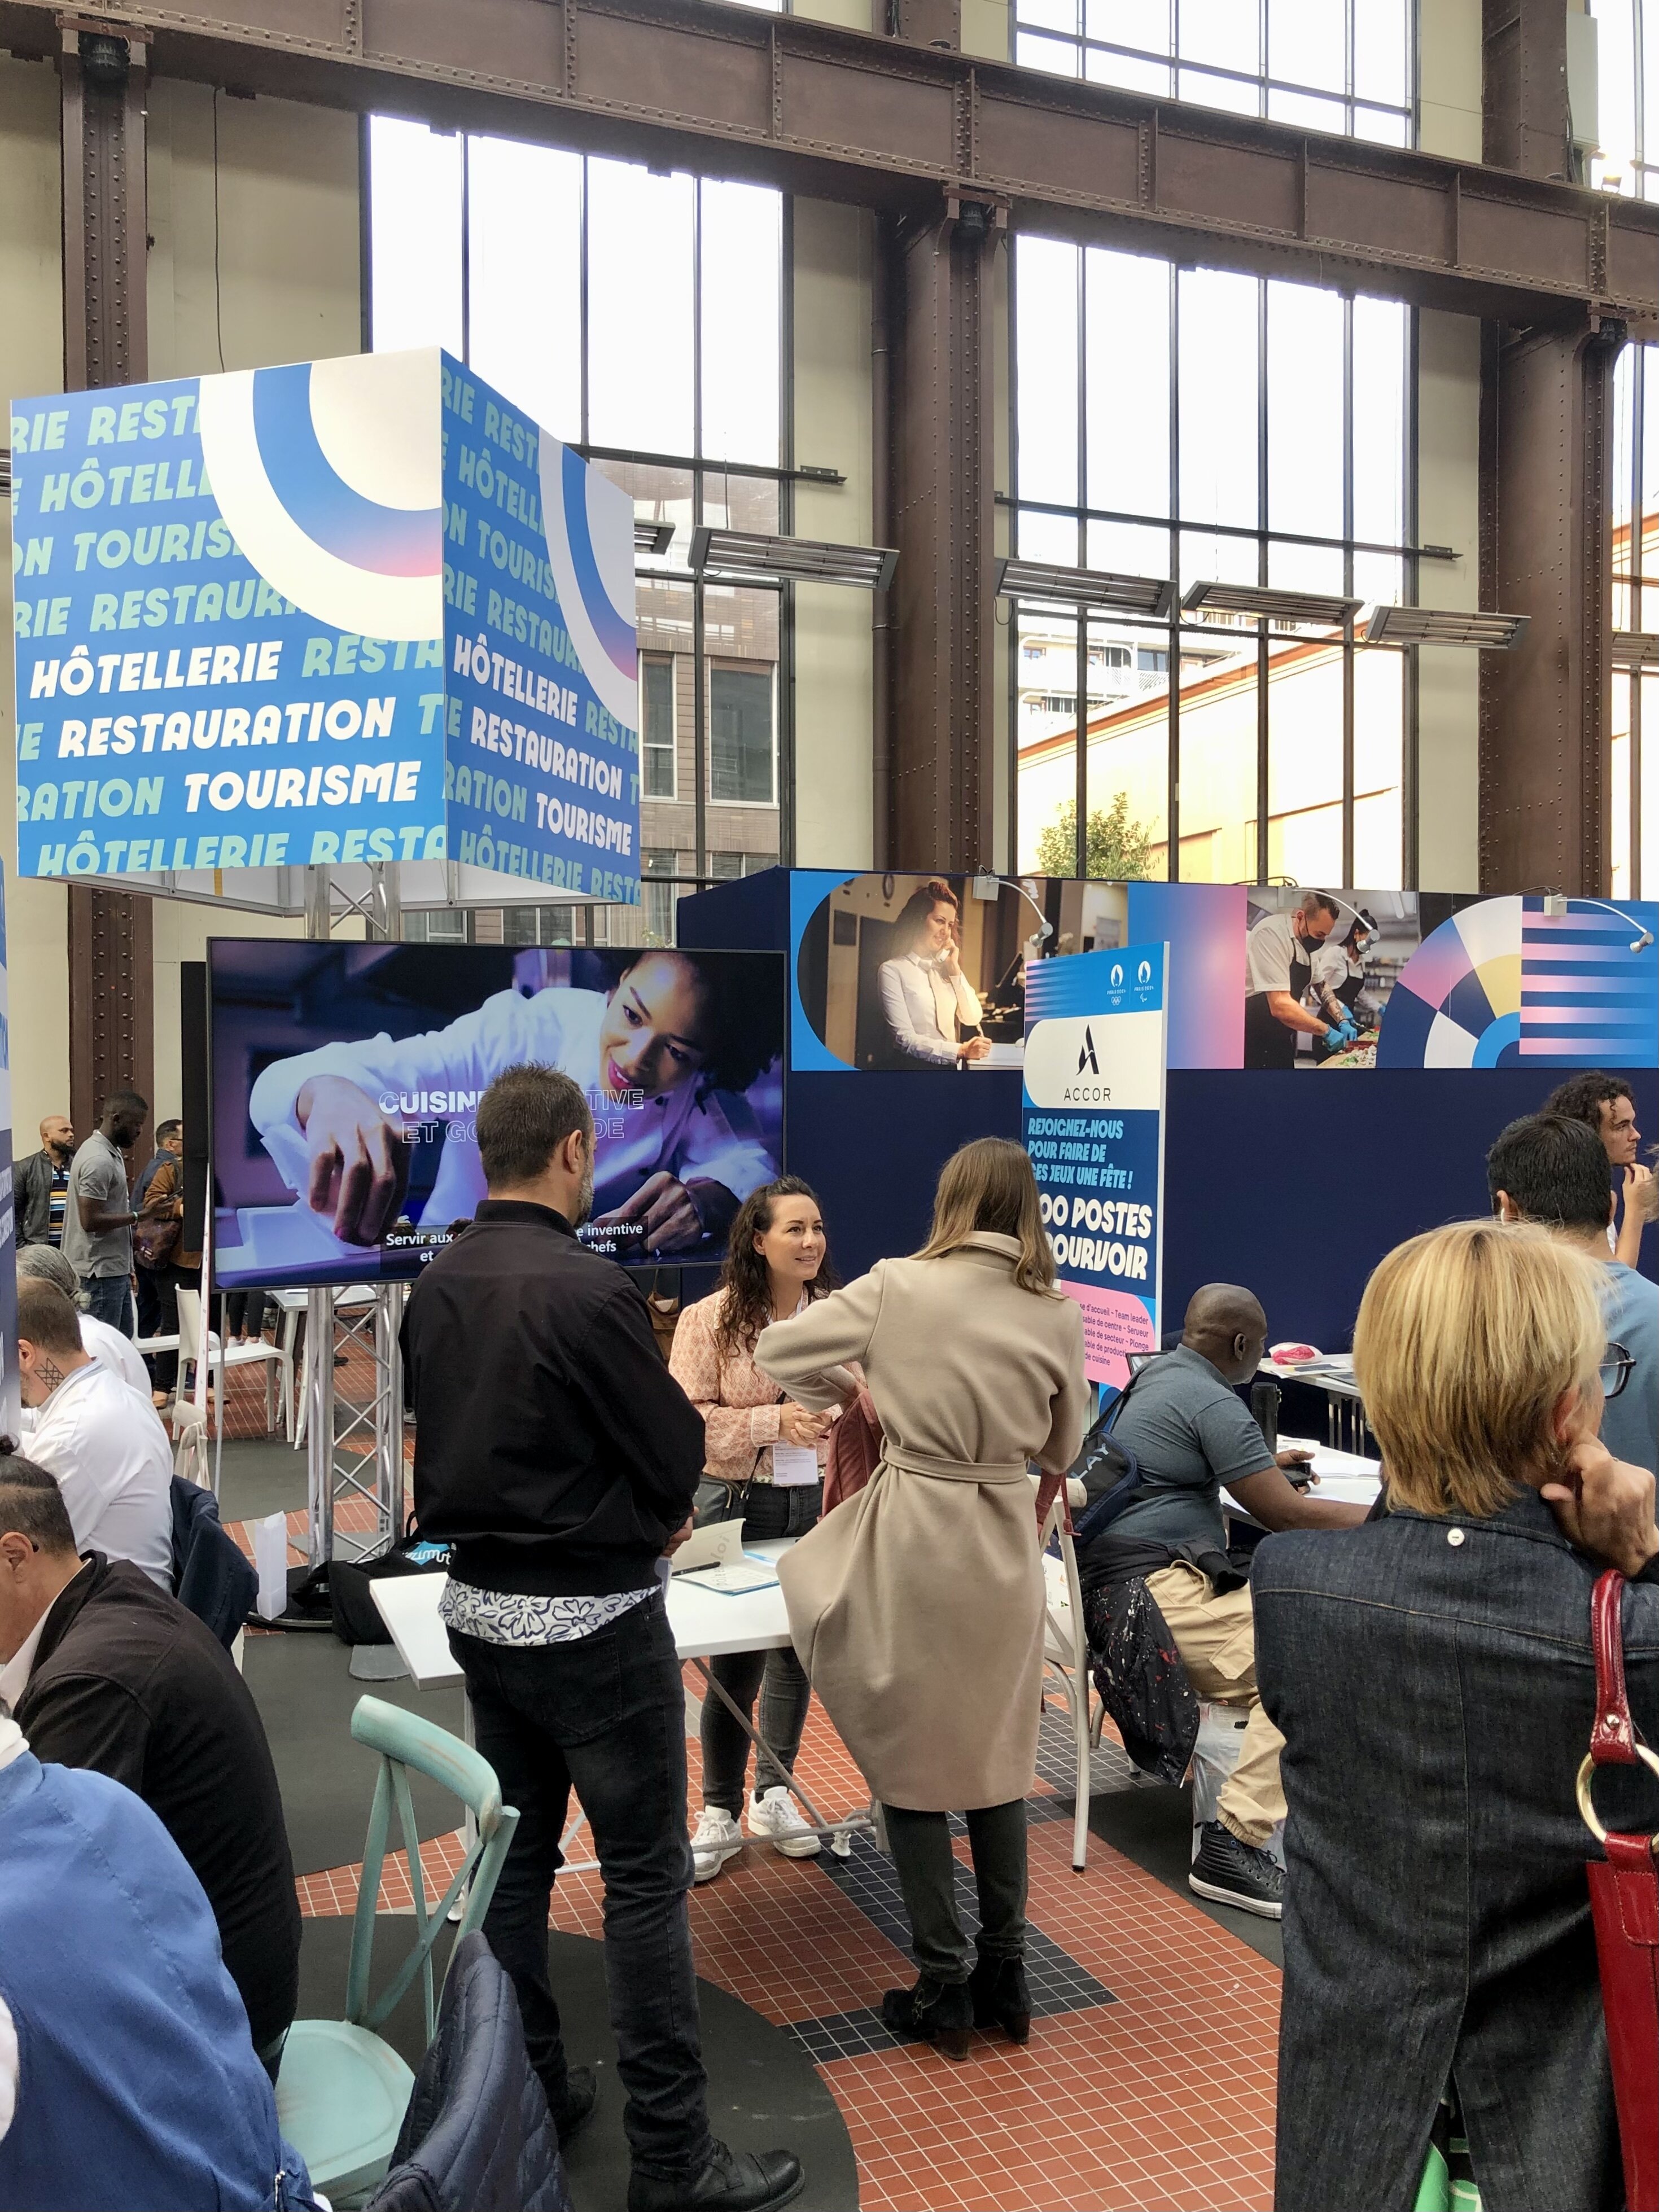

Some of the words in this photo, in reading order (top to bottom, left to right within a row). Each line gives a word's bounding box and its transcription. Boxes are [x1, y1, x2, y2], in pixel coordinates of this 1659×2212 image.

[87, 396, 200, 446] REST
[485, 400, 540, 475] REST
[74, 519, 244, 572] TOURIS
[478, 519, 559, 605] TOURIS
[90, 577, 306, 632] RESTAUR
[487, 588, 584, 674] RESTAUR
[30, 641, 283, 699] HÔTELLERIE
[453, 633, 578, 727] HÔTELLERIE
[58, 697, 396, 758] RESTAURATION
[471, 706, 622, 800] RESTAURATION
[185, 761, 422, 813] TOURISME
[536, 792, 633, 856] TOURISME
[37, 830, 290, 877] HÔTELLERIE
[459, 824, 583, 892] HÔTELLERIE
[1063, 1087, 1111, 1101] ACCOR
[402, 1120, 439, 1144] ET
[1027, 1118, 1124, 1140] REJOIGNEZ-NOUS
[1027, 1140, 1058, 1159] POUR
[1058, 1142, 1091, 1162] FAIRE
[1091, 1144, 1107, 1163] DE
[1049, 1164, 1076, 1184] JEUX
[1076, 1167, 1099, 1186] UNE
[1099, 1163, 1127, 1189] FÊTE
[386, 1232, 426, 1246] Servir
[429, 1234, 454, 1243] aux
[588, 1223, 643, 1236] inventive
[1071, 1197, 1153, 1239] POSTES
[420, 1251, 434, 1262] et
[1097, 1318, 1104, 1327] de
[1104, 1321, 1122, 1331] centre
[1127, 1325, 1149, 1338] Serveur
[1115, 1309, 1130, 1321] Team
[1130, 1313, 1149, 1325] leader
[1092, 1354, 1110, 1366] cuisine
[1096, 1330, 1104, 1339] de
[1104, 1333, 1124, 1344] secteur
[1130, 1338, 1149, 1352] Plonge
[1096, 1342, 1103, 1352] de
